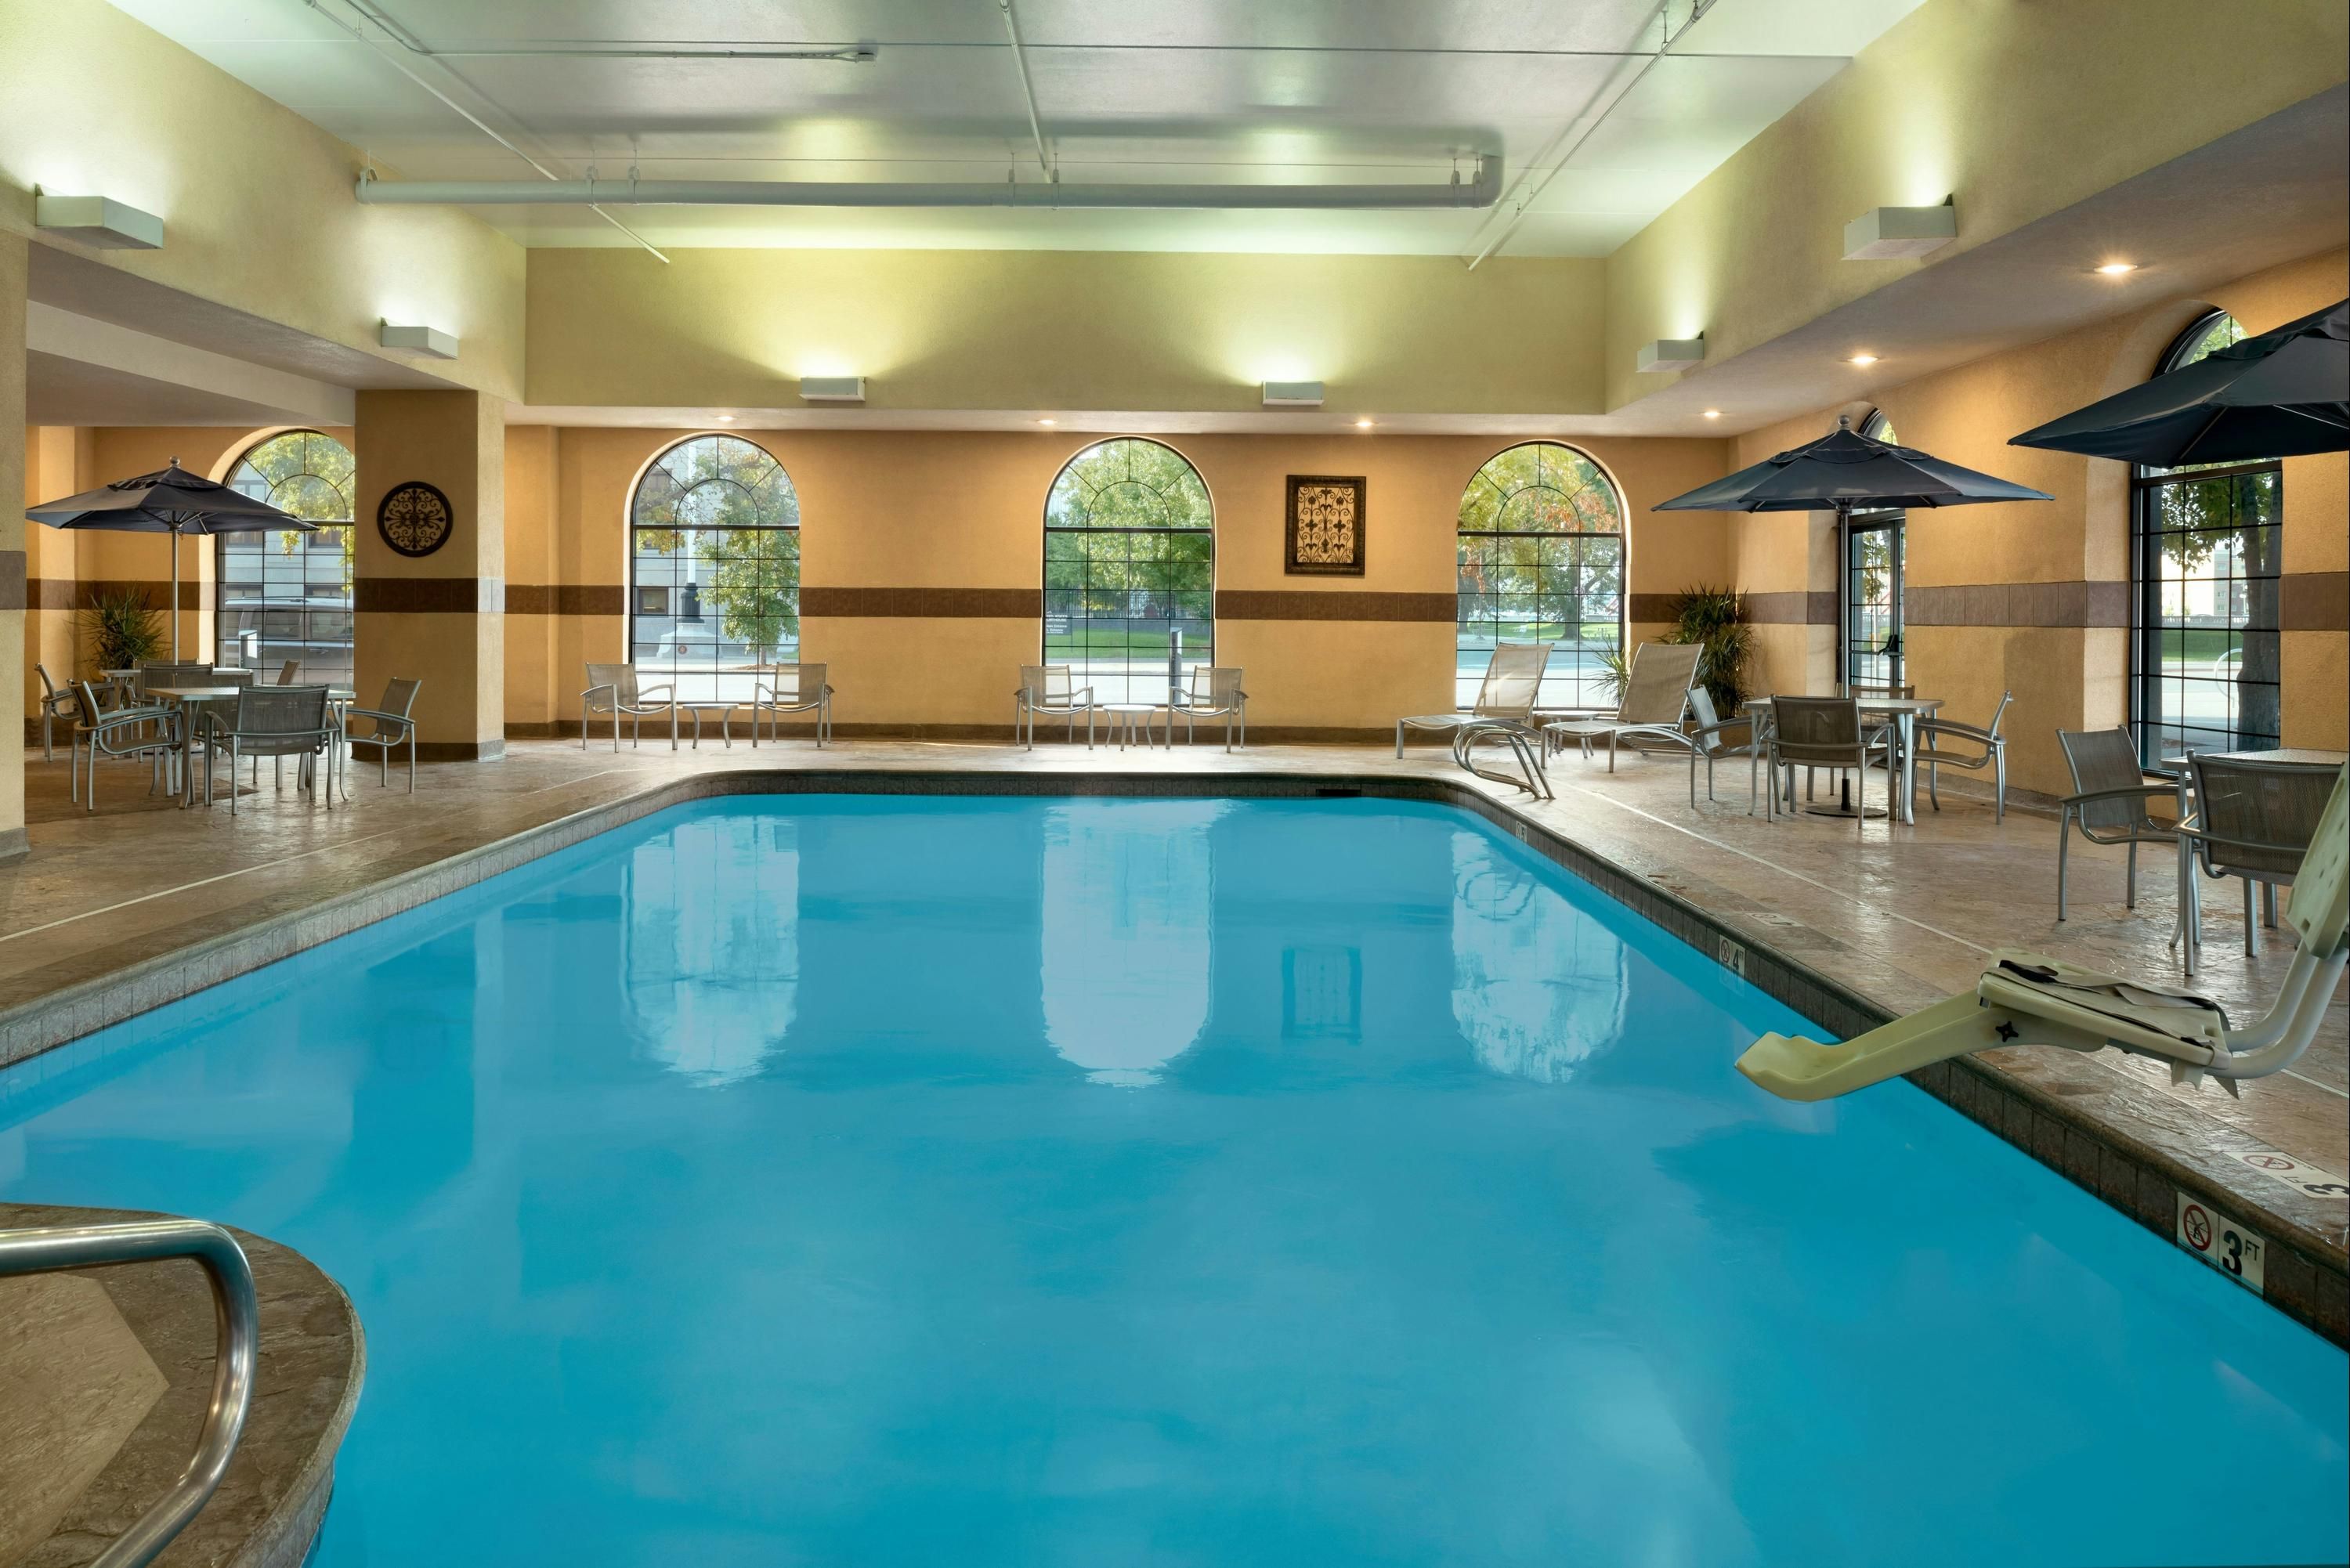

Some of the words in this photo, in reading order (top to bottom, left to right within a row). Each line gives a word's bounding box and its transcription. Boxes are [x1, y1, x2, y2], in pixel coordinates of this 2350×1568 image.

[1732, 948, 1739, 970] 4
[2303, 1183, 2349, 1195] 3
[2222, 1230, 2243, 1276] 3
[2244, 1239, 2260, 1261] FT
